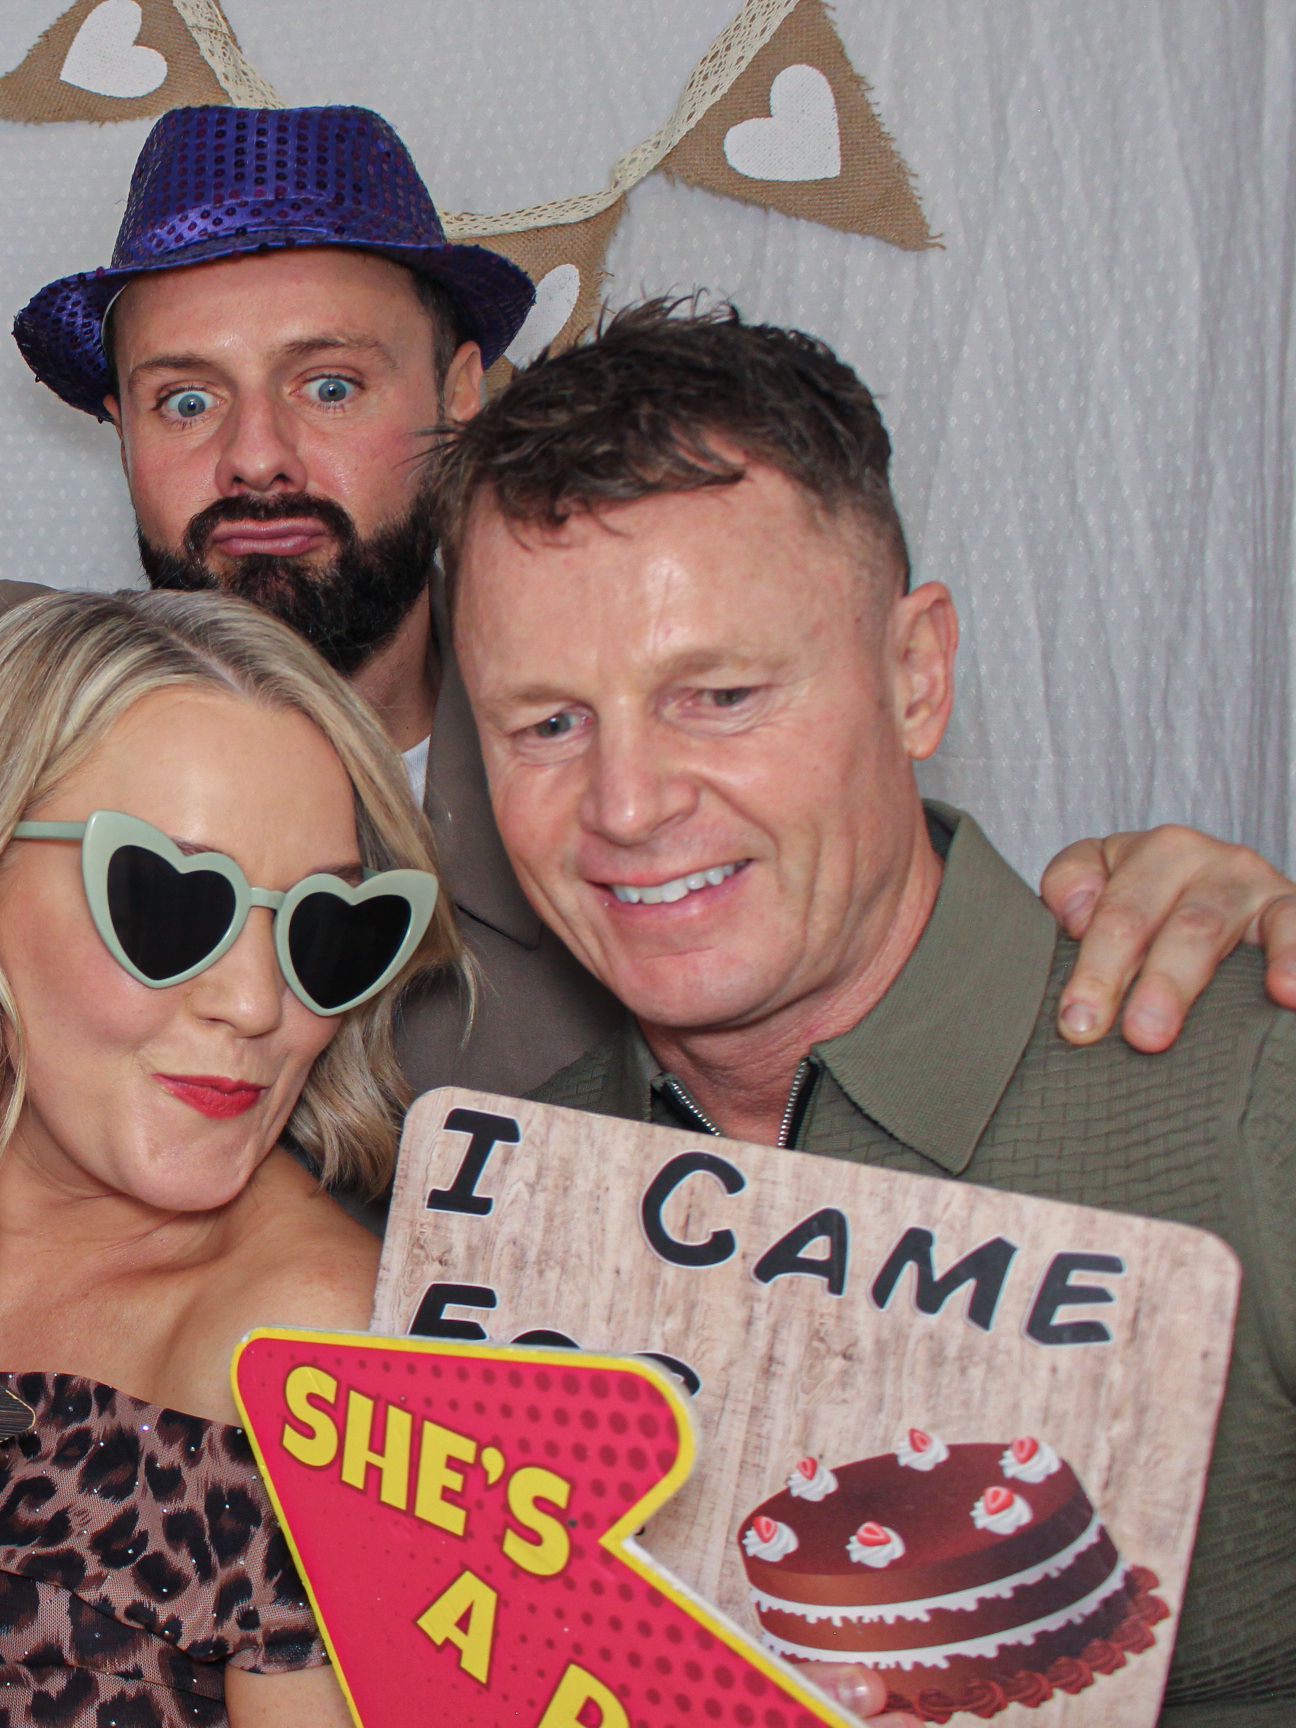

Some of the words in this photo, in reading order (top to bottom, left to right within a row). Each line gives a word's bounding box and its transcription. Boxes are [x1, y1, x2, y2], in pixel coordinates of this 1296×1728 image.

[426, 1106, 521, 1217] I
[640, 1150, 1128, 1347] CAME
[282, 1366, 572, 1577] SHE'S
[416, 1571, 497, 1685] A
